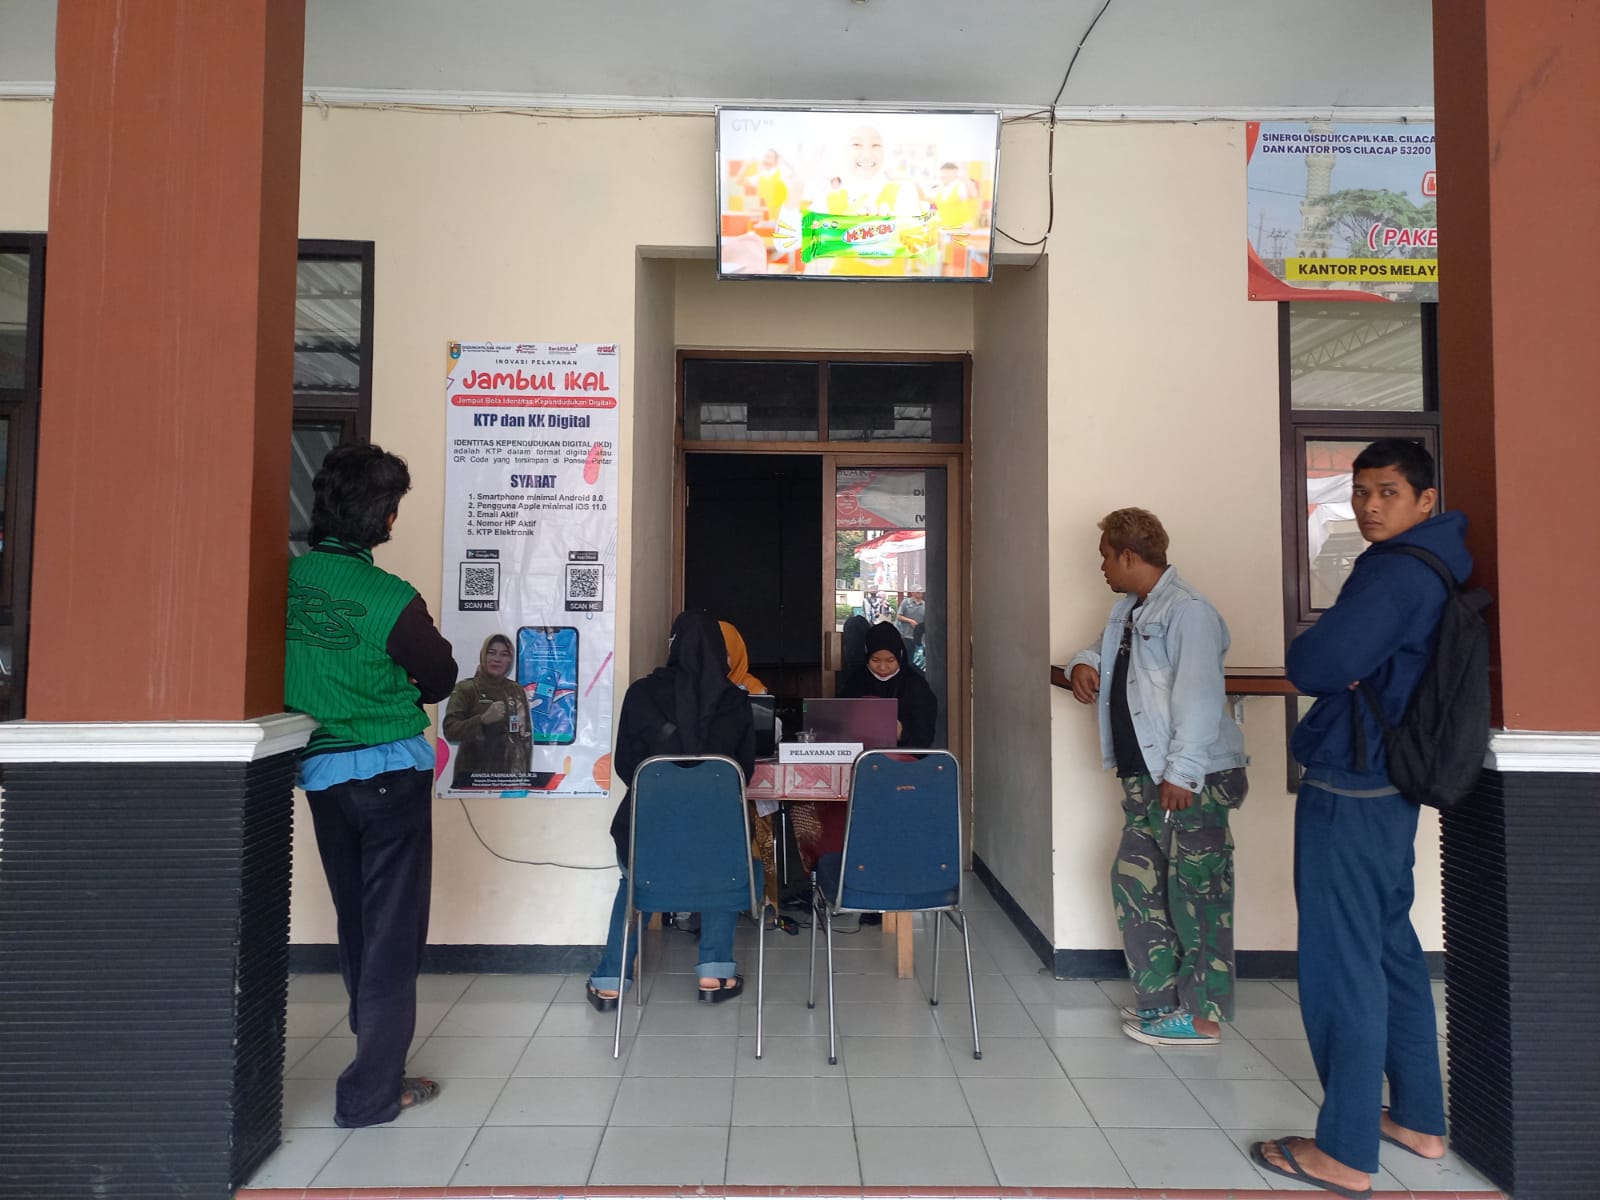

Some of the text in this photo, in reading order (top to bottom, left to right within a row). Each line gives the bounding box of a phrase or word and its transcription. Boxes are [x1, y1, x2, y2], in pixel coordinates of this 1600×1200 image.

[1262, 134, 1302, 142] SINERGI
[1304, 134, 1372, 142] DISDUKCAPIL
[1373, 135, 1397, 143] KAB.
[1263, 145, 1432, 155] DAN KANTOR POS CILACAP 53200
[1299, 264, 1437, 276] KANTOR POS MELAY
[462, 369, 609, 391] Jambul IKAL
[474, 413, 590, 429] KTP dan KK Digital
[594, 441, 612, 449] (IKD)
[566, 449, 590, 457] digital
[510, 474, 557, 489] SYARAT
[477, 493, 524, 501] Smartphone
[477, 502, 516, 510] Pengguna
